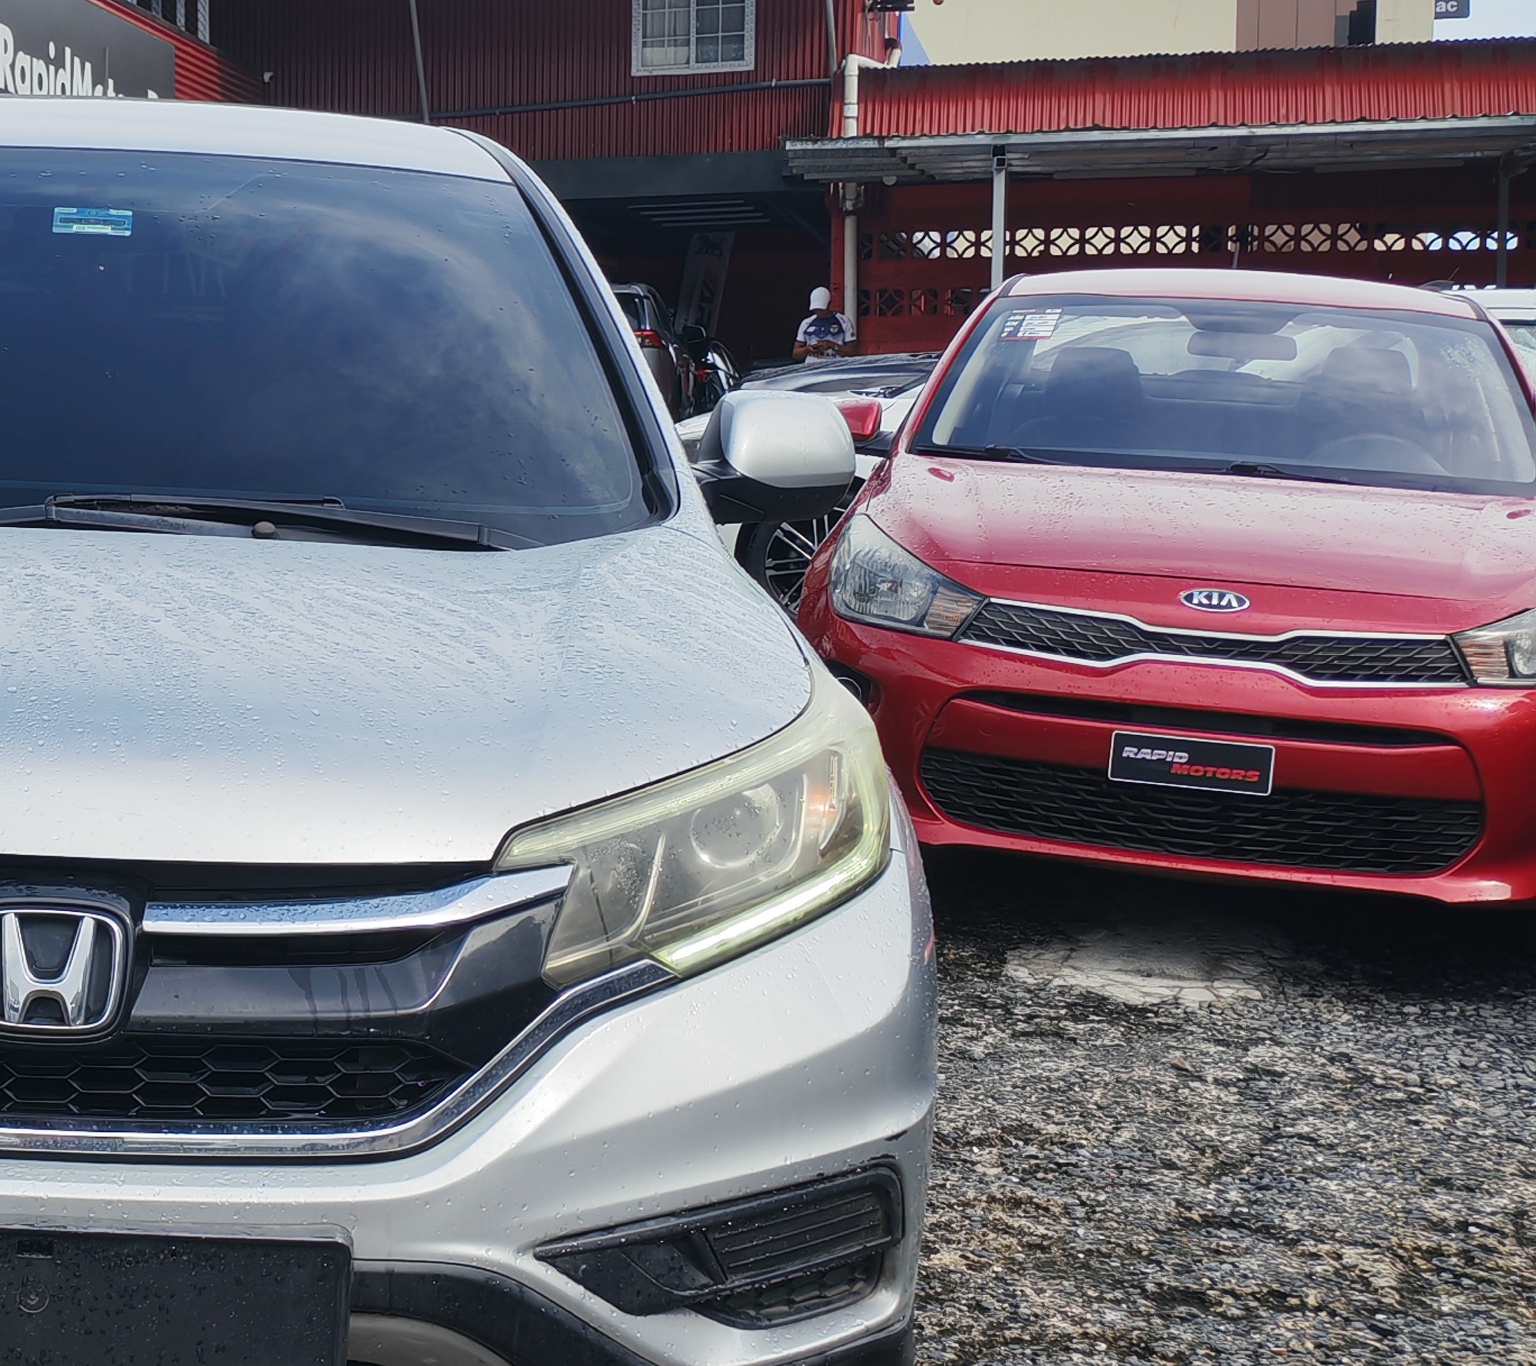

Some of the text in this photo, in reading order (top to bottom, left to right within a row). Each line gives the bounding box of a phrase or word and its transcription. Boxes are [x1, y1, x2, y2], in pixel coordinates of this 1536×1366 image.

[1435, 0, 1458, 13] ac
[1192, 591, 1239, 608] KIA
[1122, 746, 1189, 764] RAPID
[1170, 763, 1261, 782] MOTORS
